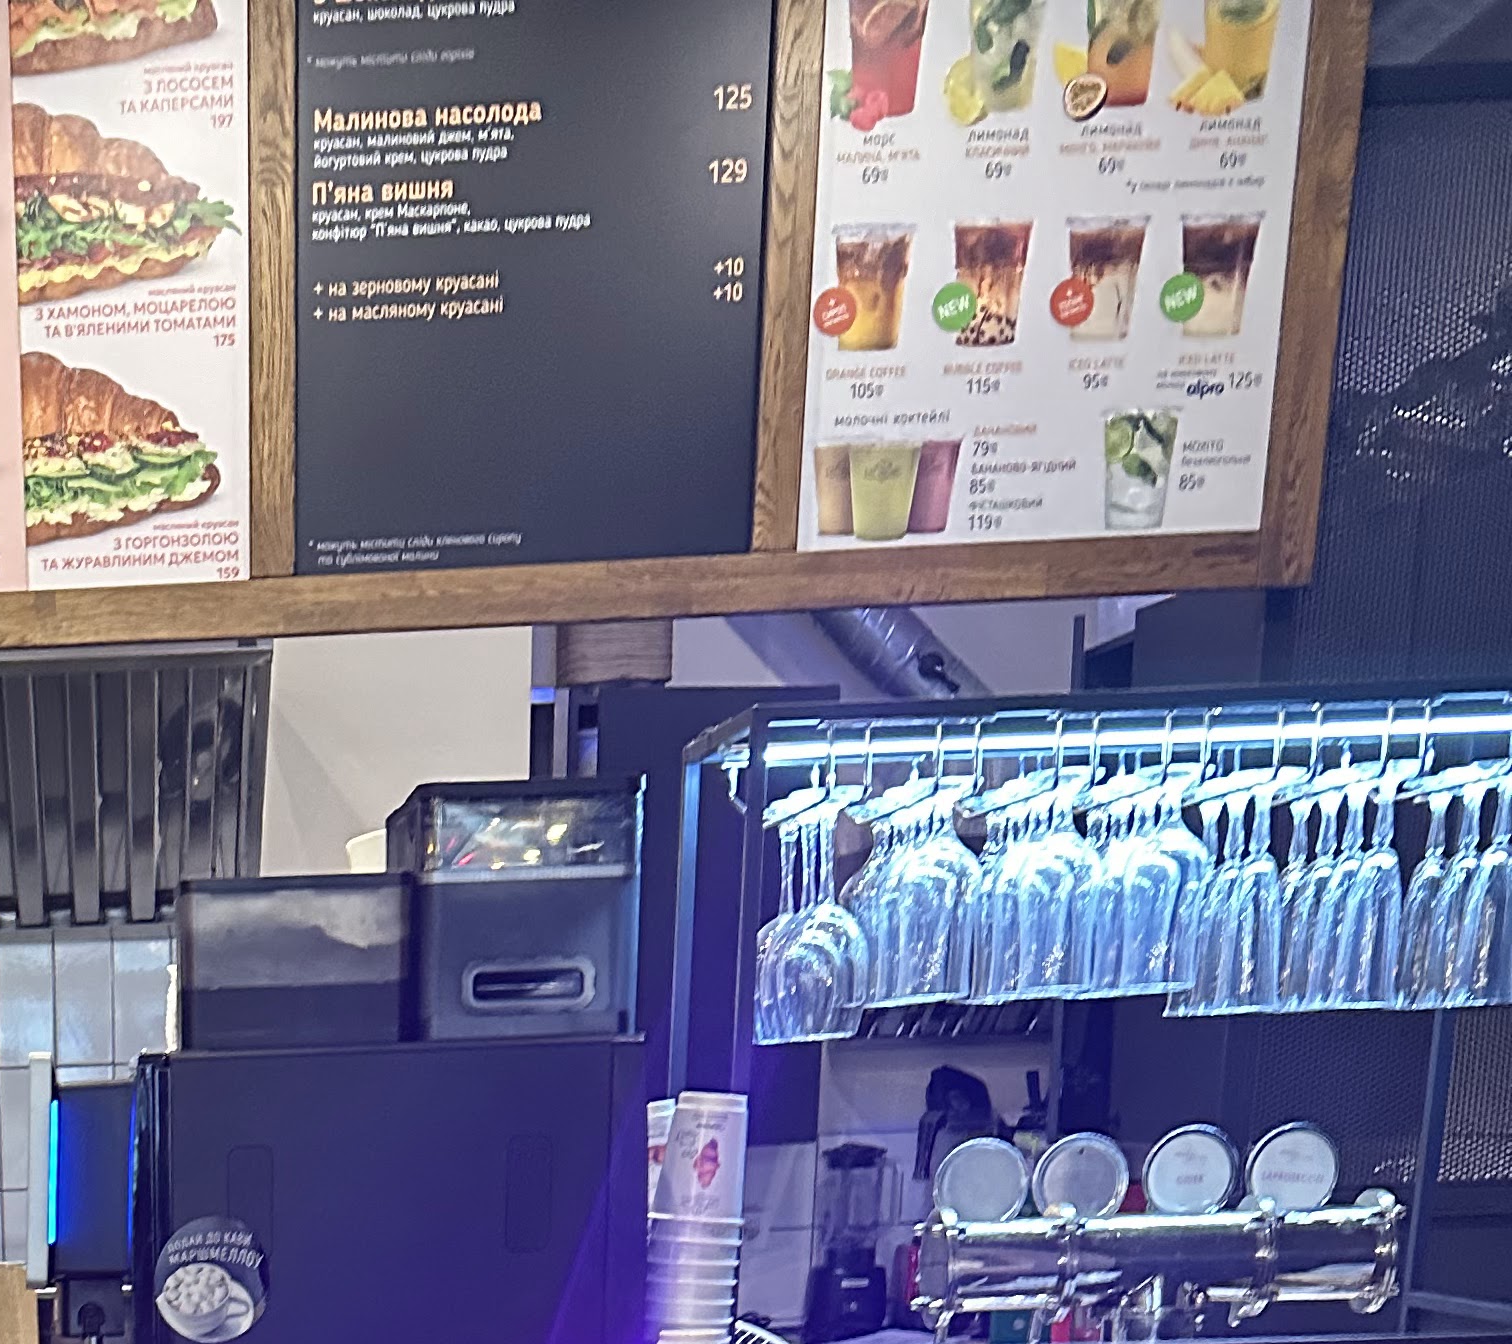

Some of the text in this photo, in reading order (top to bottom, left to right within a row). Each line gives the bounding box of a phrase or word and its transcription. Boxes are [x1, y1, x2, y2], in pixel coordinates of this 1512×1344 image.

[156, 75, 234, 94] ЛОСОСЕМ
[140, 94, 234, 113] КАПЕРСАМИ
[314, 83, 753, 133] Малинова насолода 125
[210, 113, 234, 129] 197
[312, 157, 748, 206] П'яна вишня 129
[329, 256, 744, 298] на зерновому круасані +10
[133, 297, 236, 317] МОЦАРЕЛОЮ
[329, 281, 743, 322] на масляному круасані +10
[938, 295, 970, 319] NEW
[154, 315, 236, 334] ТОМАТАМИ
[213, 333, 236, 347] 175
[1187, 379, 1224, 399] alpro
[124, 531, 239, 549] ГОРГОНЗОЛОЮ
[62, 553, 166, 571] ЖУРАВЛИНИМ
[168, 549, 240, 567] ДЖЕМОМ
[216, 566, 240, 580] 159
